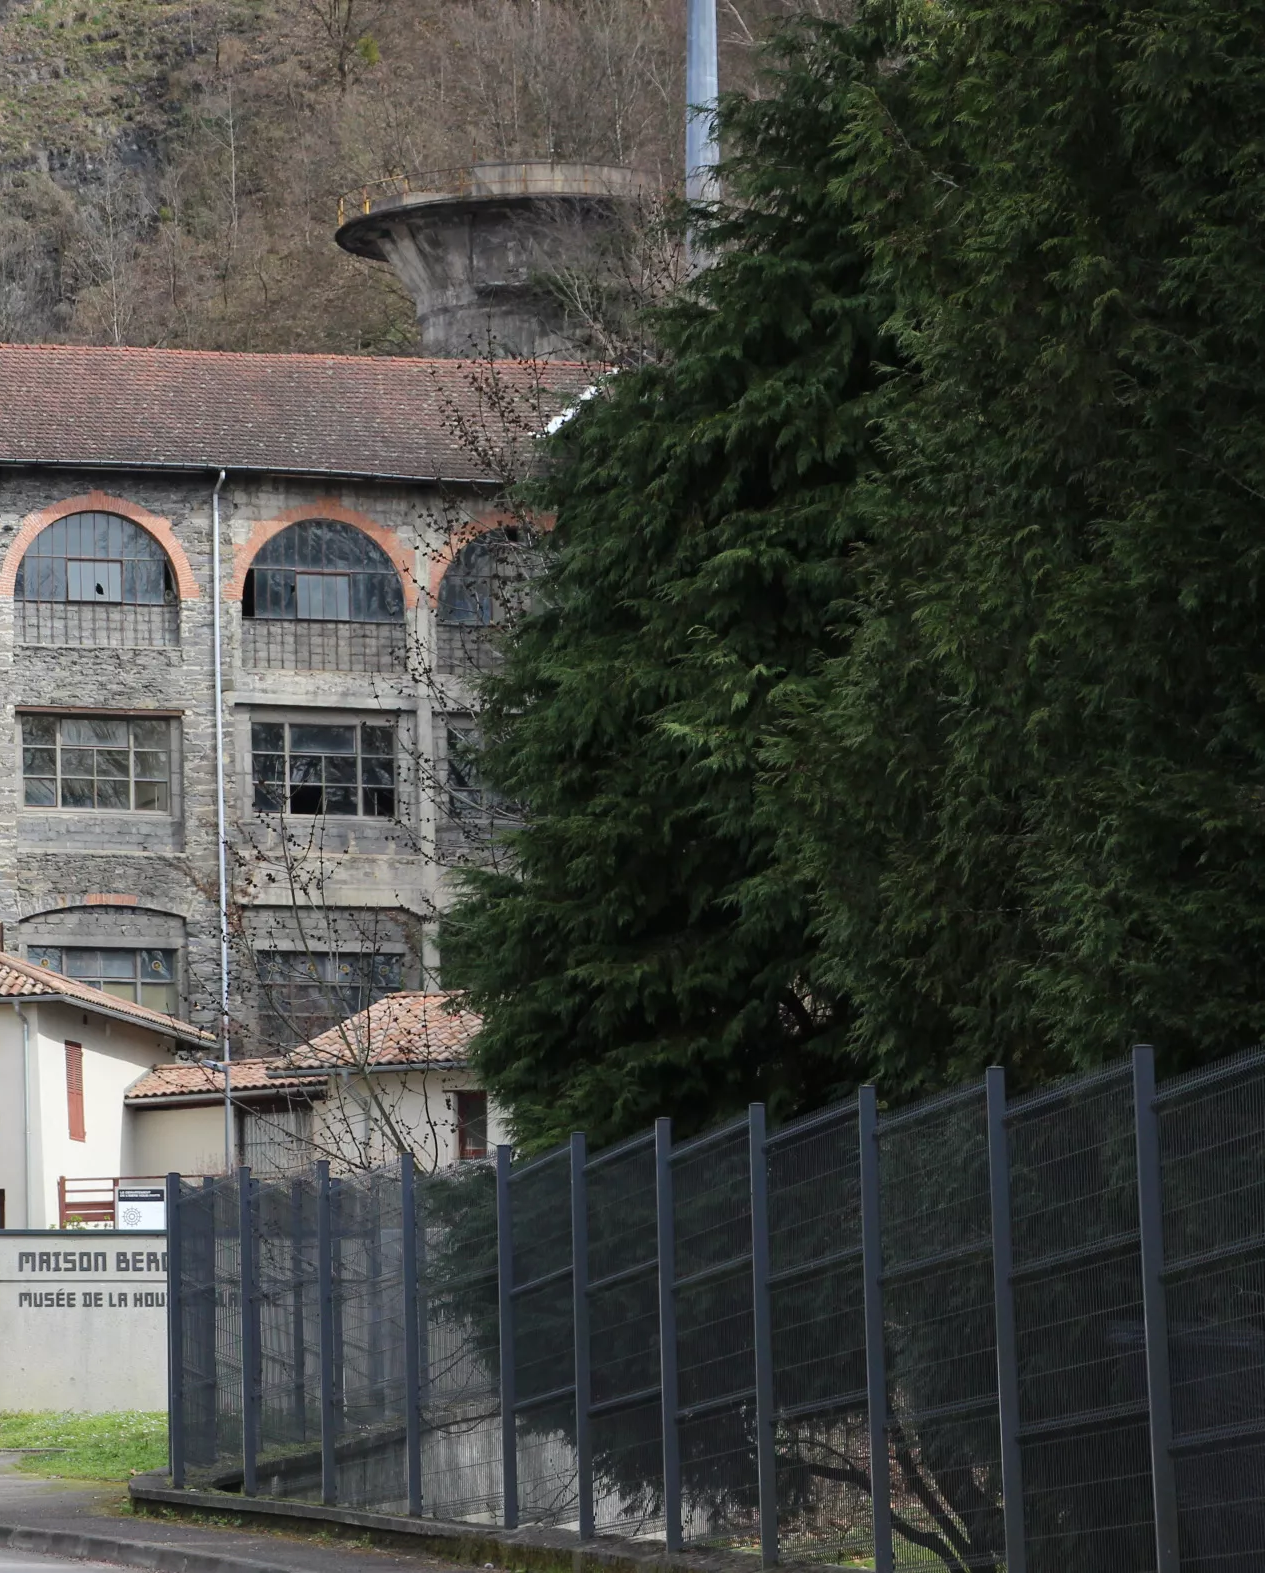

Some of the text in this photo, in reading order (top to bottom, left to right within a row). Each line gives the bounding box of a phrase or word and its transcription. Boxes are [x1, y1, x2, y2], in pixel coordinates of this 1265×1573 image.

[18, 1252, 107, 1272] MAISON
[18, 1288, 168, 1308] MUSÉE DE LA HOU
